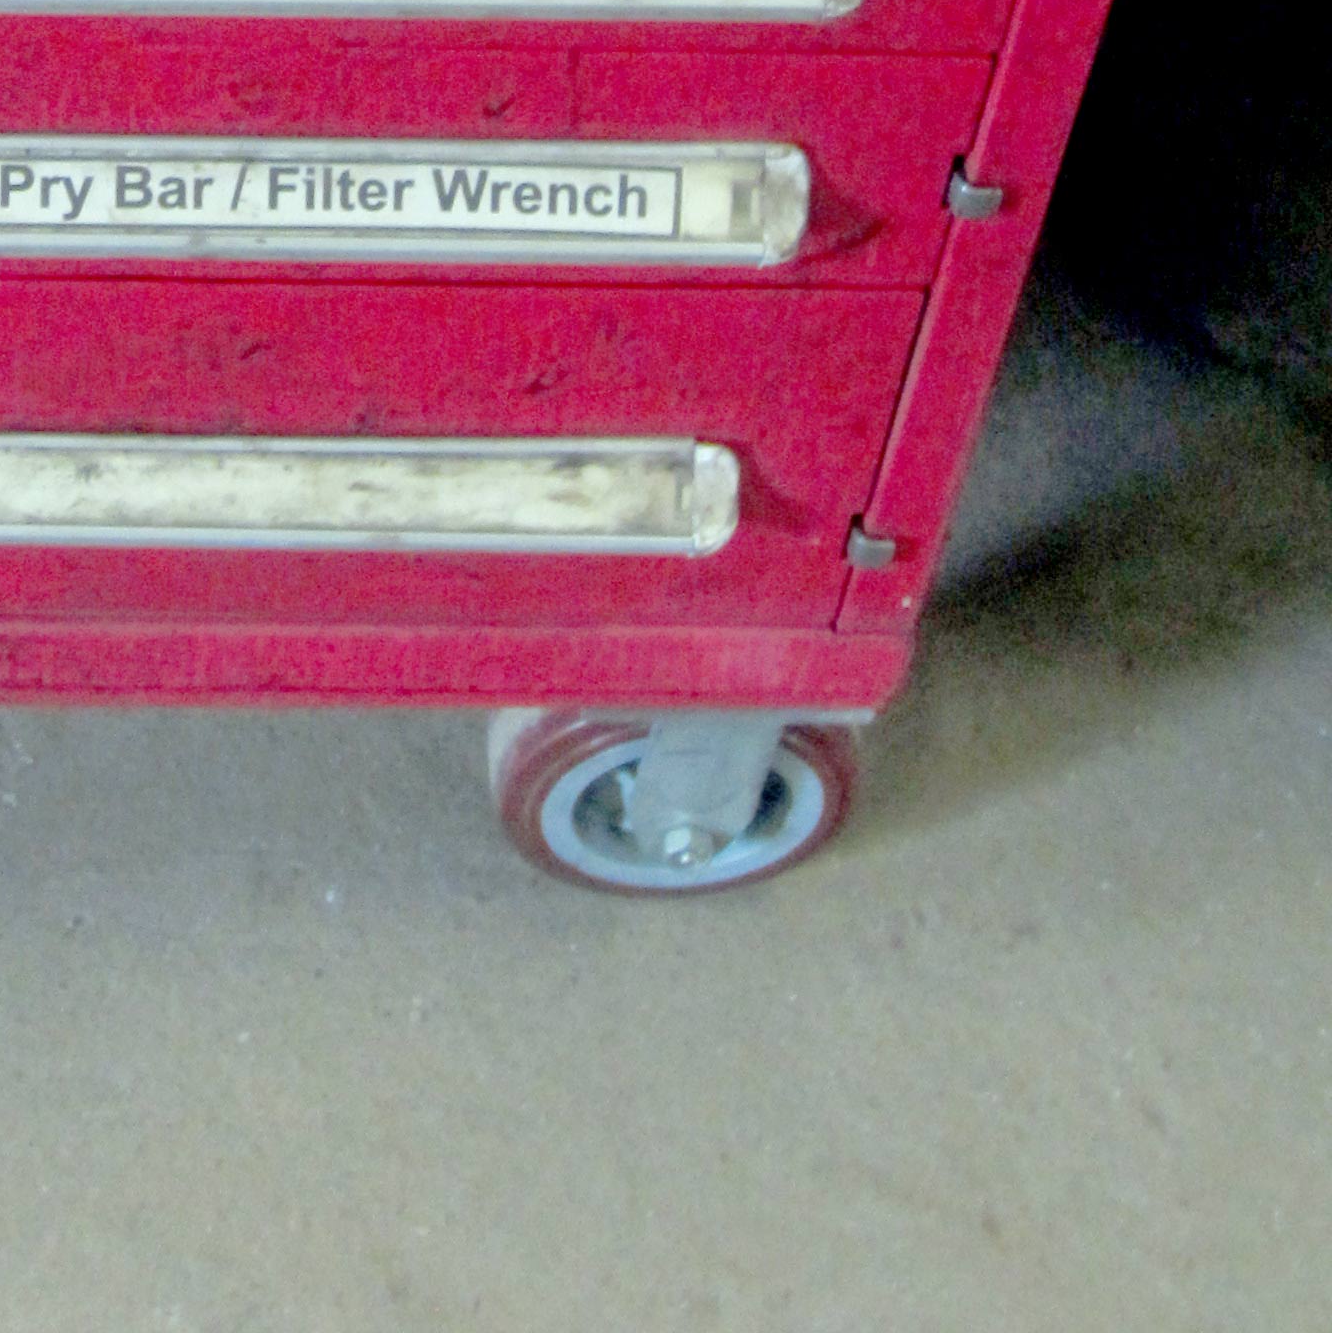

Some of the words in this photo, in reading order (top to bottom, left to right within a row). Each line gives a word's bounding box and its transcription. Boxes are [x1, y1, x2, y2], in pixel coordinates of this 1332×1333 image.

[0, 165, 92, 220] Pry
[115, 165, 213, 211] Bar
[268, 167, 412, 215] Filter
[434, 169, 647, 219] Wrench
